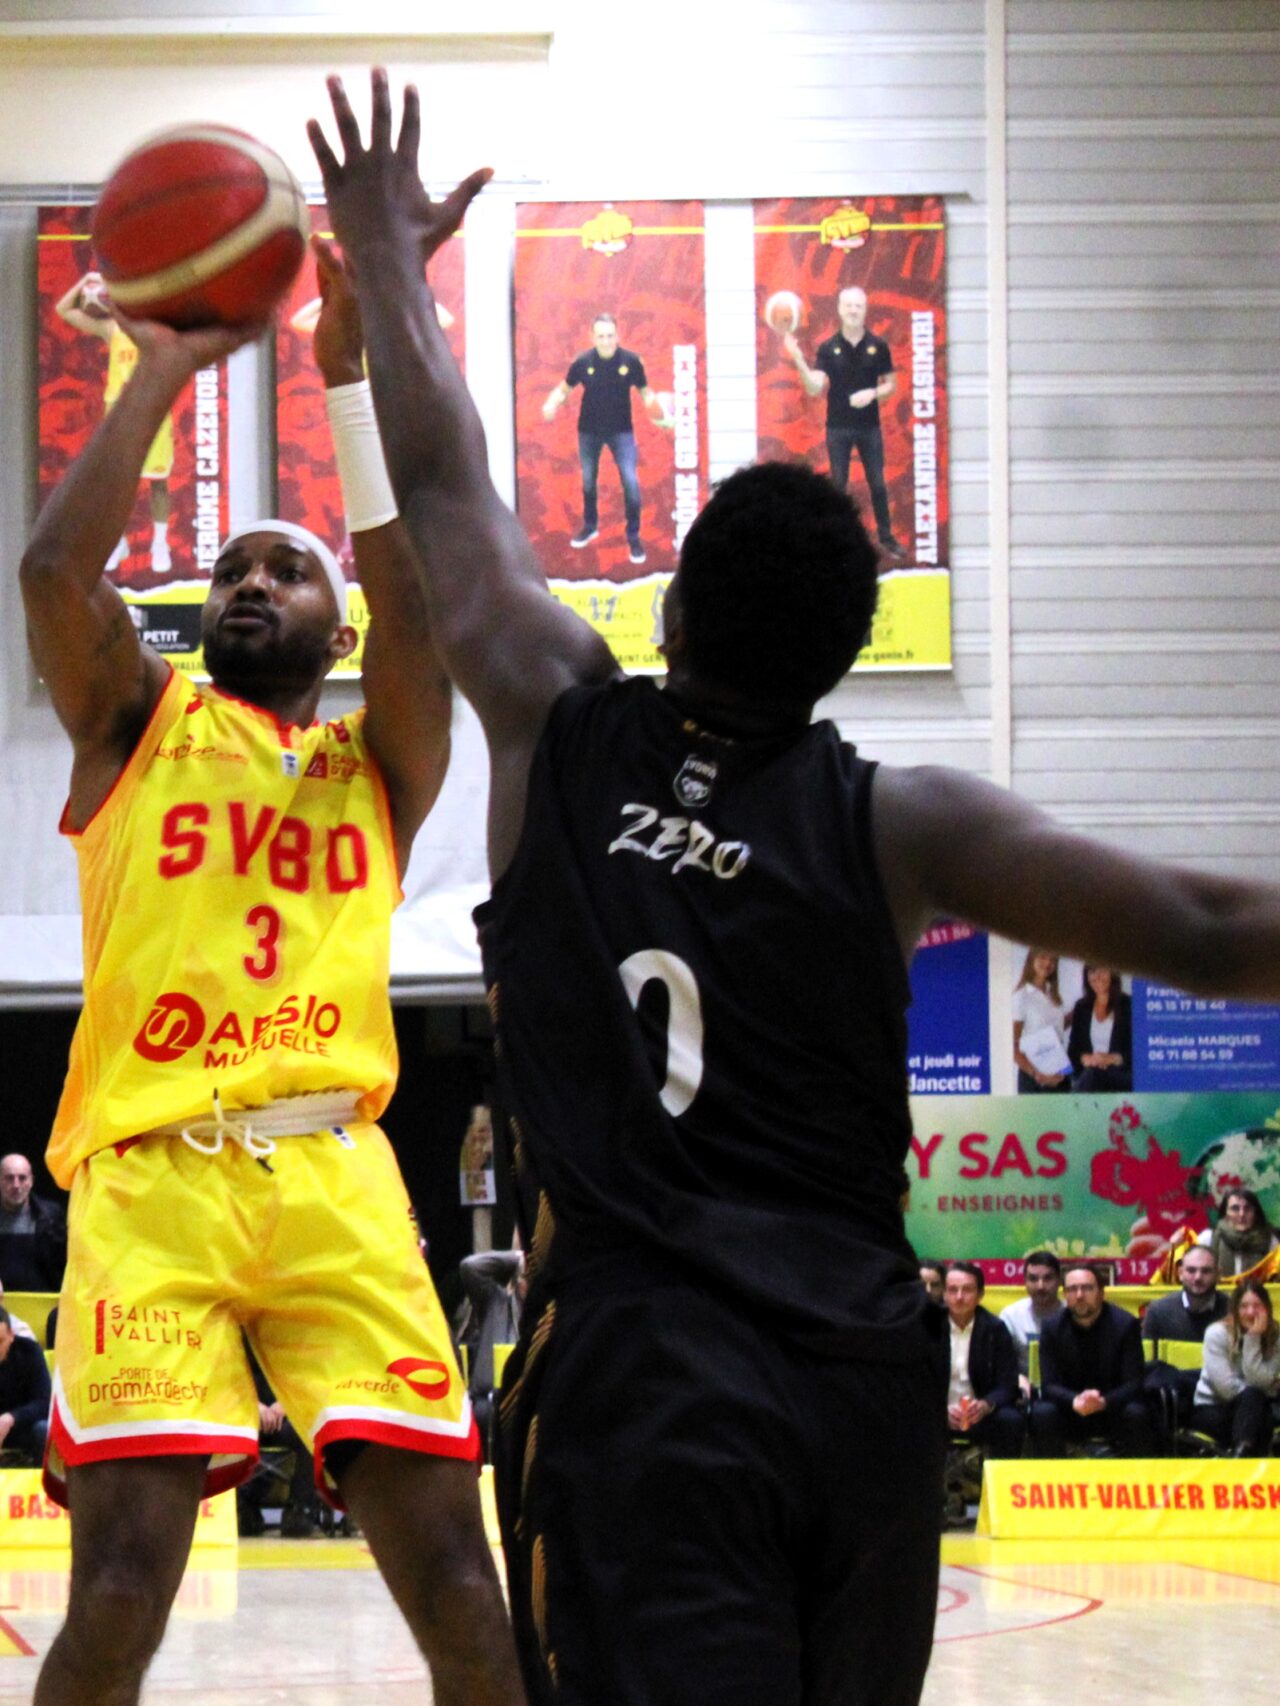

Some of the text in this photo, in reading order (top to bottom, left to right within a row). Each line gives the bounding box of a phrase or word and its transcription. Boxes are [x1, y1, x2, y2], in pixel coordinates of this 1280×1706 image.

[195, 362, 219, 476] CAZENOB
[158, 802, 370, 894] SVBD
[242, 903, 282, 982] 3
[958, 1131, 1068, 1179] SAS
[937, 1194, 1063, 1212] ENSEIGNES
[111, 1305, 181, 1324] SAINT
[1009, 1483, 1206, 1510] SAINT-VALLIER
